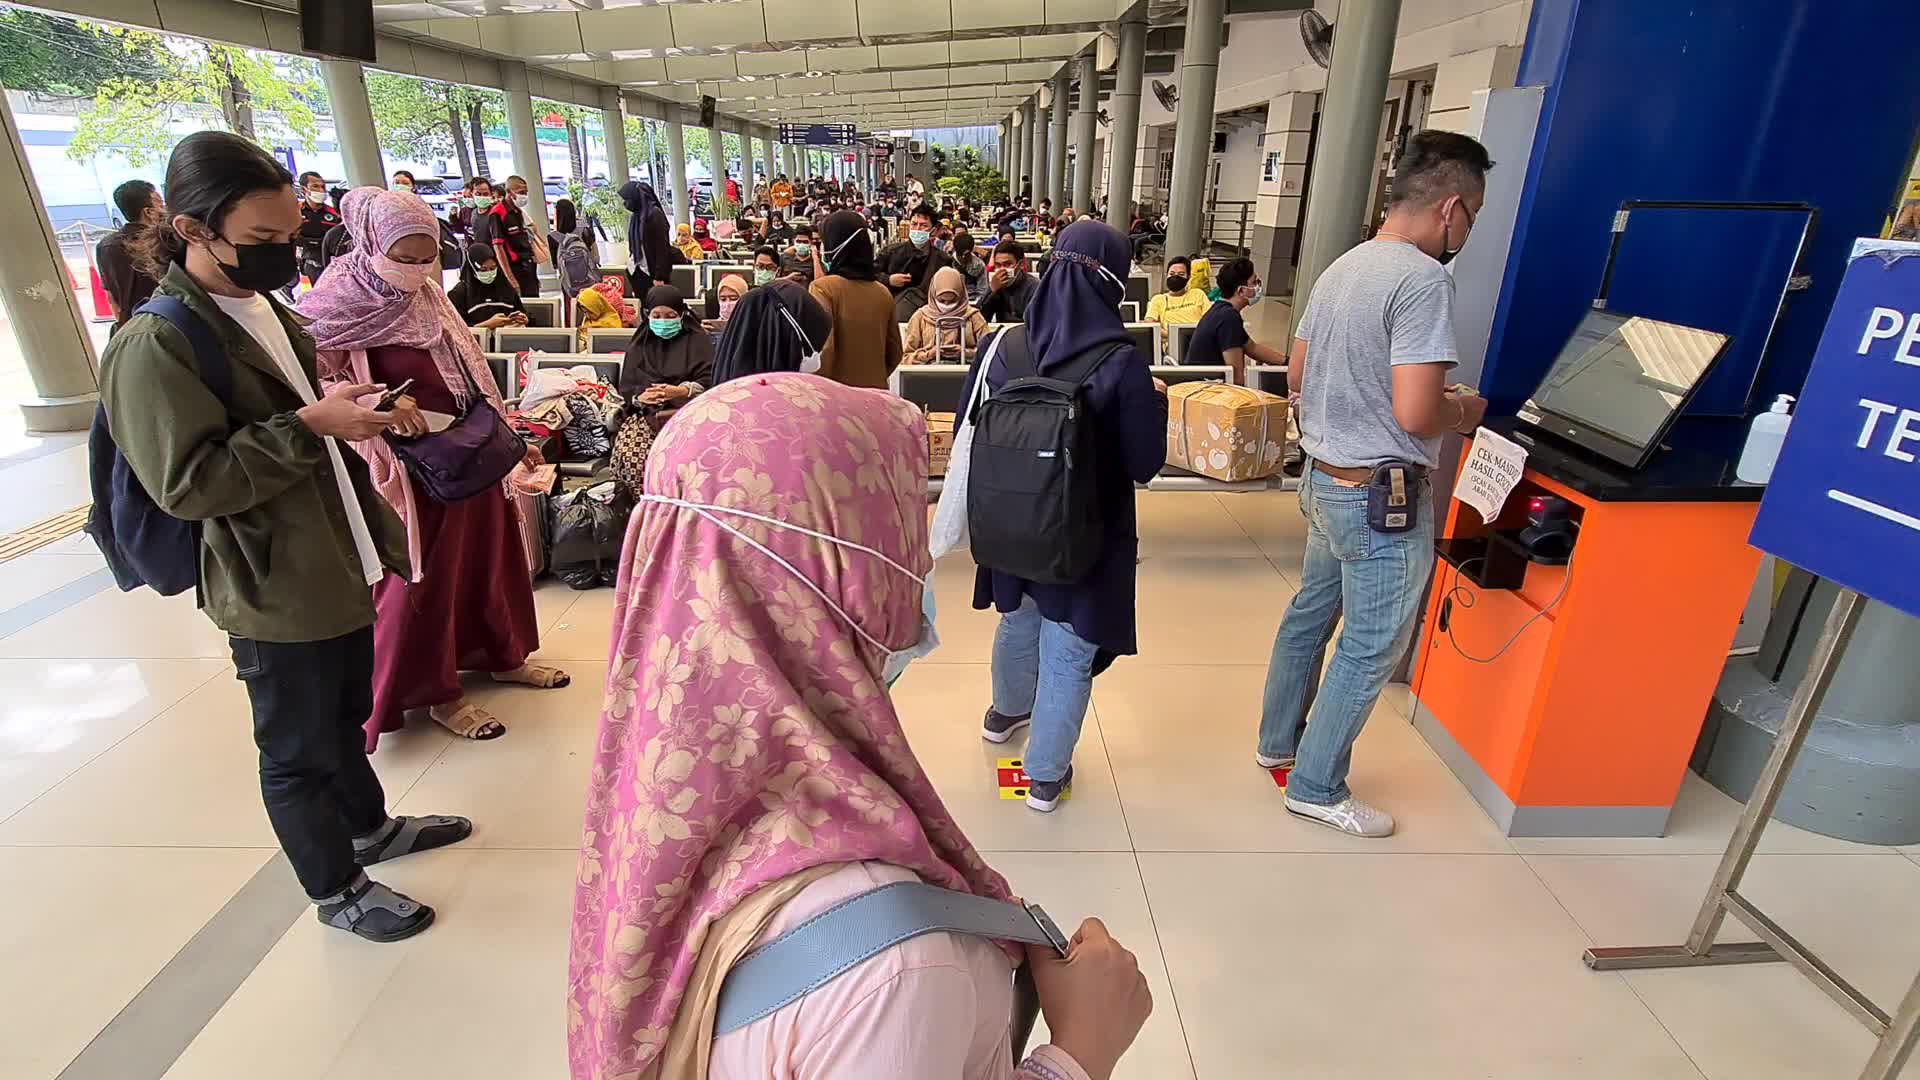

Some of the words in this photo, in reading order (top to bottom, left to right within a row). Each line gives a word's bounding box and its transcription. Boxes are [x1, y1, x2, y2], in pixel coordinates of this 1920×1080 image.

[1857, 306, 1920, 367] PE
[1856, 398, 1920, 463] TE
[1470, 458, 1494, 480] HASIL
[1477, 447, 1493, 464] CEK
